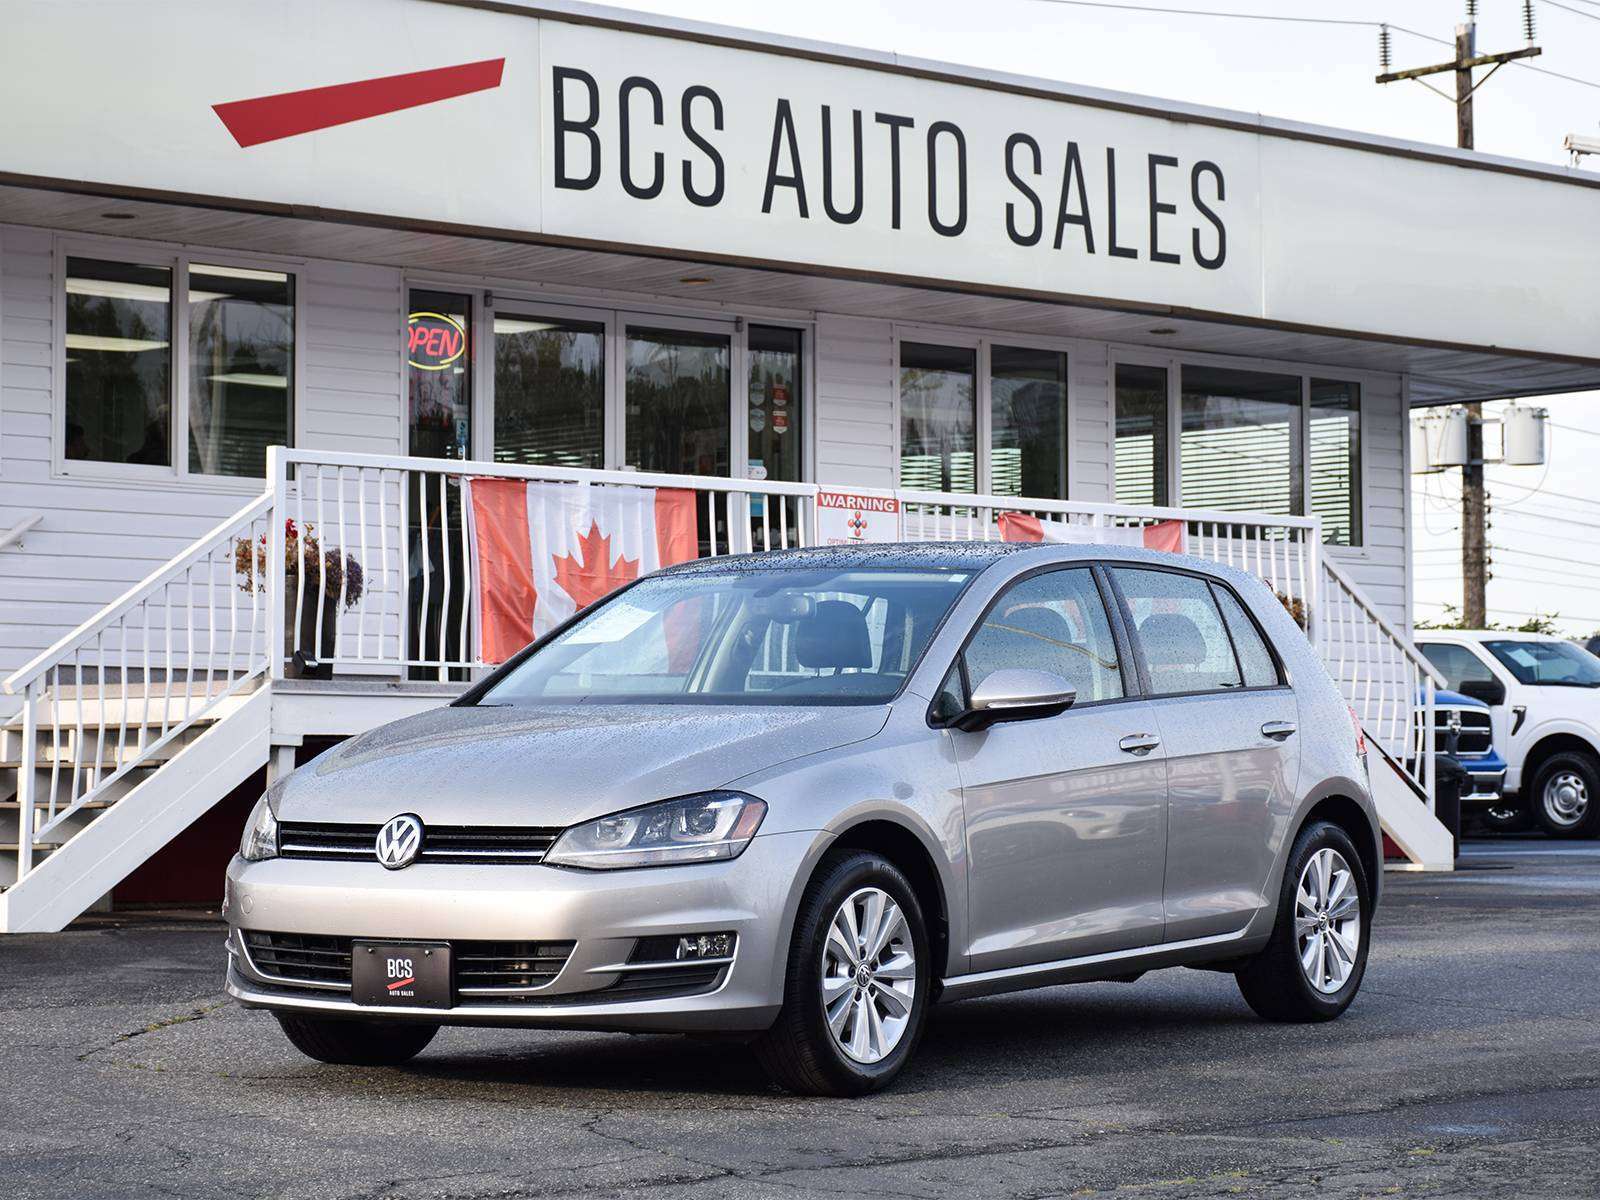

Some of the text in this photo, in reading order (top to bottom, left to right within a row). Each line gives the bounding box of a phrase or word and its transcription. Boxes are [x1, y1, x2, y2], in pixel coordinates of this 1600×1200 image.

[552, 65, 1227, 270] BCS AUTO SALES
[820, 494, 895, 511] WARNING
[387, 958, 413, 978] BCS
